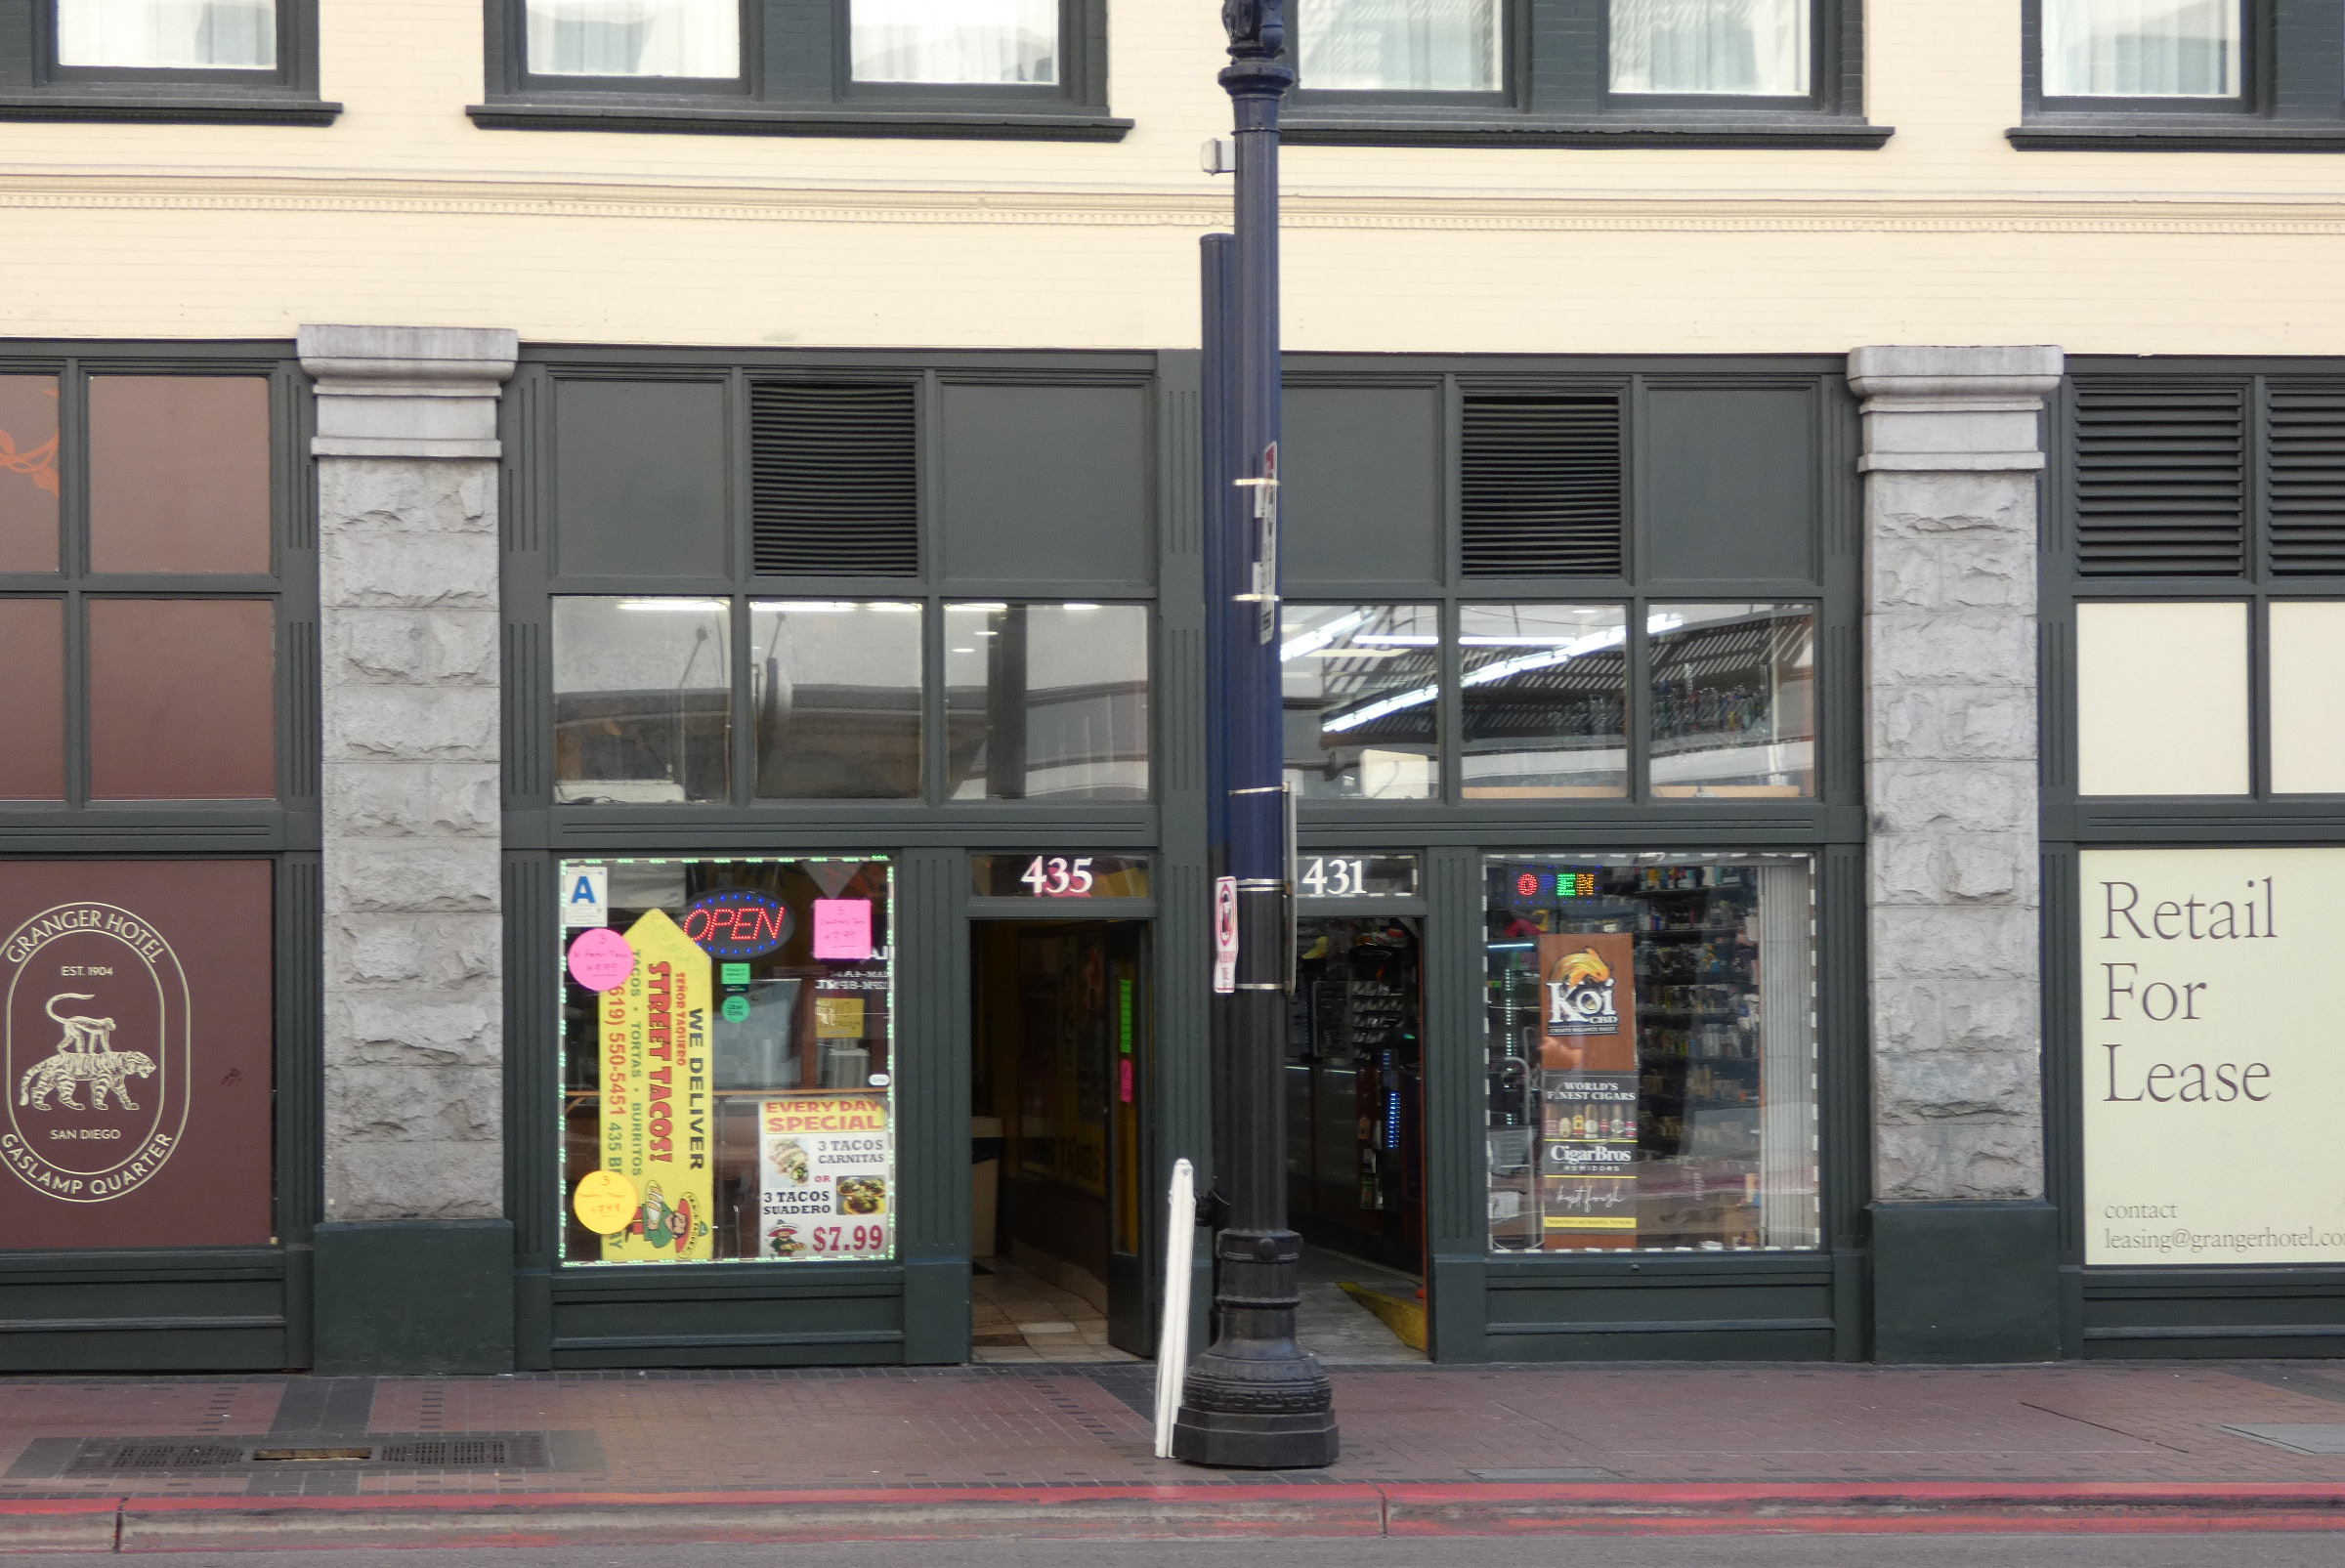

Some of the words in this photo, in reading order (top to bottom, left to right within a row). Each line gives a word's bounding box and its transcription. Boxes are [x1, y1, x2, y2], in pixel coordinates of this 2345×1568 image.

[571, 875, 597, 904] A
[1020, 855, 1093, 894] 435
[1301, 857, 1367, 895] 431
[1517, 872, 1596, 896] OPEN
[684, 906, 786, 941] OPEN
[2100, 875, 2279, 940] Retail
[6, 910, 103, 963] GRANGER
[106, 912, 165, 963] HOTEL
[61, 965, 86, 976] EST.
[88, 965, 114, 976] 1904
[630, 949, 642, 997] TACOS
[676, 972, 688, 1009] SEÑOR
[1546, 978, 1618, 1023] Koi
[2101, 962, 2208, 1021] For
[648, 960, 672, 1061] STREET
[689, 1007, 704, 1048] WE
[631, 1021, 642, 1078] TORTAS
[676, 1012, 688, 1066] TAQUERO
[609, 1033, 627, 1116] 550-5451
[1563, 1082, 1618, 1091] WORLD'S
[2102, 1043, 2273, 1103] Lease
[689, 1057, 704, 1170] DELIVER
[766, 1101, 834, 1114] EVERY
[839, 1100, 880, 1113] DAY
[1591, 1091, 1636, 1101] CIGARS
[649, 1066, 673, 1163] TACOS!
[767, 1115, 882, 1132] SPECIAL
[50, 1129, 77, 1140] SAN
[80, 1128, 121, 1140] DIEGO
[608, 1122, 623, 1152] 435
[631, 1102, 643, 1177] BURRITOS
[818, 1140, 827, 1151] 3
[831, 1139, 884, 1152] TACOS
[1, 1133, 84, 1194] GASLAMP
[89, 1133, 173, 1195] QUARTER
[818, 1154, 885, 1165] CARNITAS
[1550, 1145, 1632, 1165] CigarBros
[763, 1205, 831, 1215] SUADERO
[764, 1192, 773, 1204] 3
[777, 1190, 831, 1203] TACOS
[2104, 1202, 2178, 1219] contact
[812, 1224, 884, 1252] $7.99
[2105, 1226, 2345, 1253] leasing@grangerhotel.co
